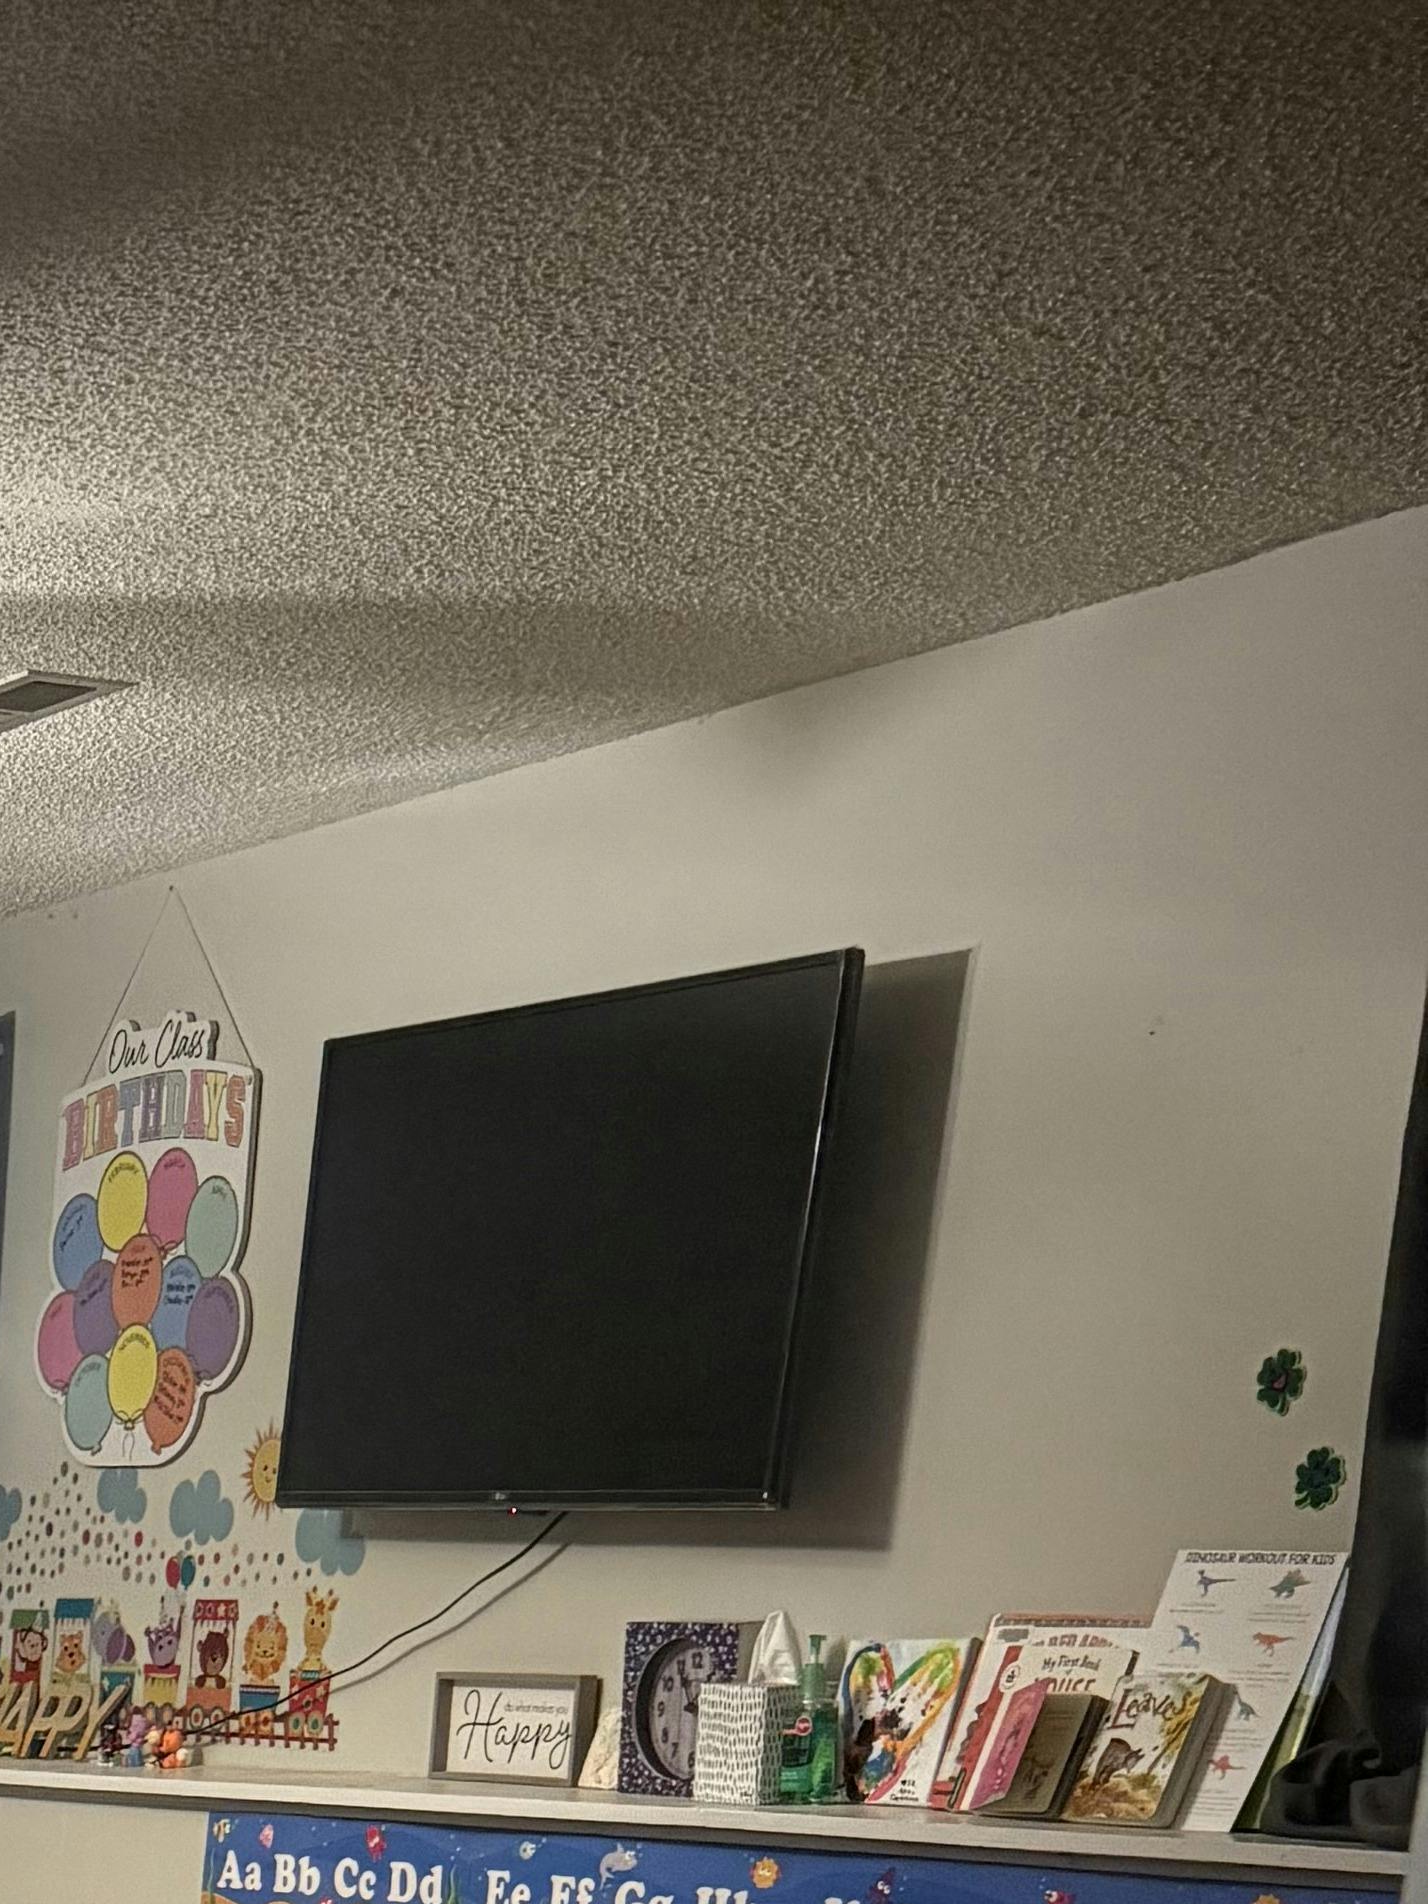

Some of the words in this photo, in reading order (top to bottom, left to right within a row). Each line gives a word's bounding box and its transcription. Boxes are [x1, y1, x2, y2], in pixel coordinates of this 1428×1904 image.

[108, 1028, 149, 1075] Our
[154, 1018, 205, 1069] Class
[62, 1068, 247, 1173] BIRTHDAYS
[1238, 1551, 1288, 1565] WORKOUT
[1288, 1552, 1310, 1565] FOR
[1311, 1553, 1336, 1566] KIDS
[691, 1652, 703, 1669] 12
[662, 1676, 674, 1693] 10
[656, 1701, 665, 1718] 9
[1107, 1686, 1194, 1730] Leaves
[456, 1689, 573, 1770] Happy
[660, 1727, 670, 1743] 8
[671, 1741, 680, 1758] 7
[216, 1849, 262, 1892] Aa
[273, 1852, 321, 1896] Bb
[332, 1857, 376, 1901] Cc
